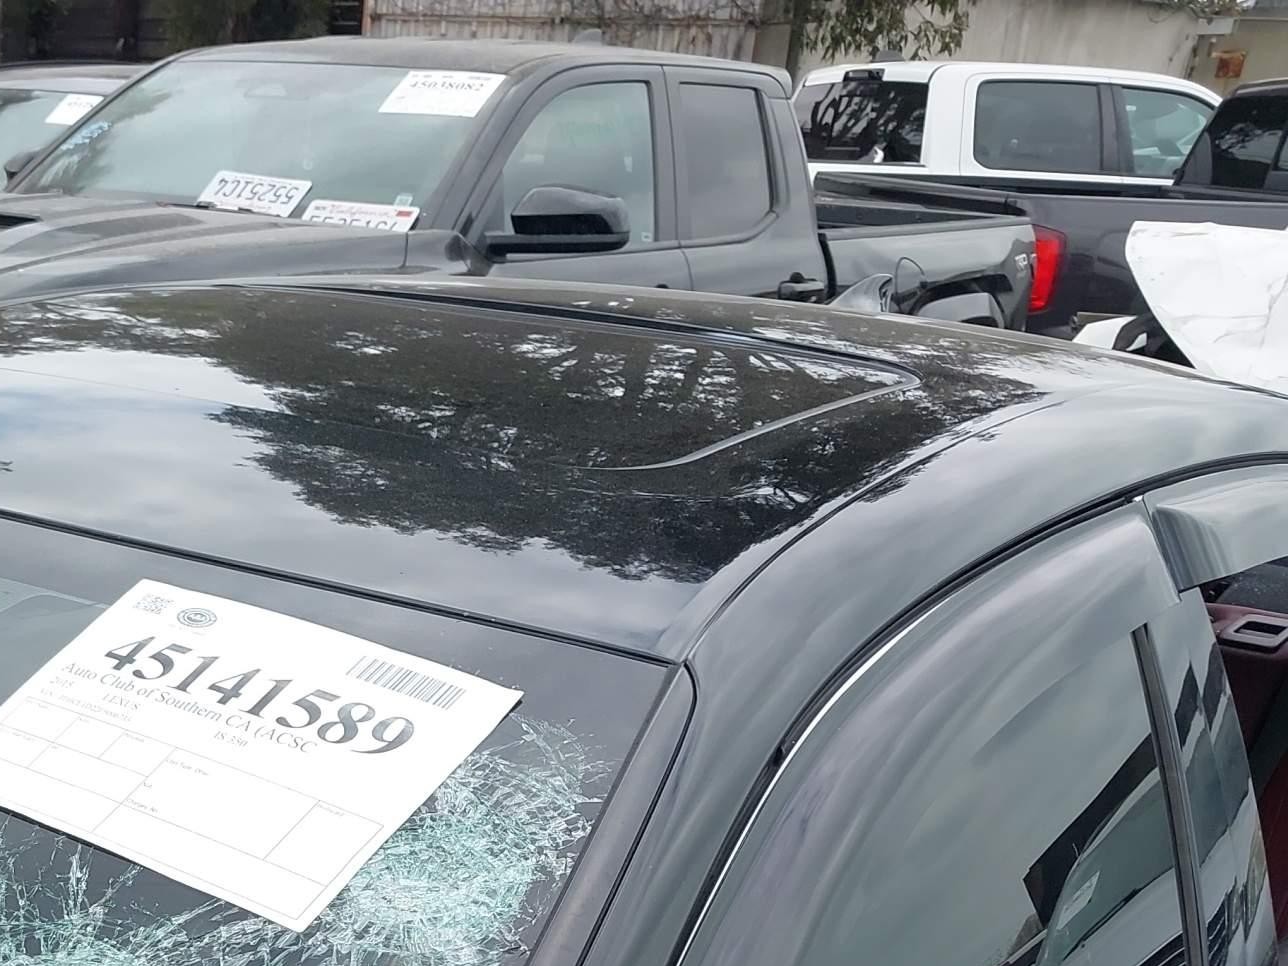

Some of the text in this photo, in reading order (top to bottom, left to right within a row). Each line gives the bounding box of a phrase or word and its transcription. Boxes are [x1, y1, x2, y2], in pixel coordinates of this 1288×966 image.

[216, 178, 300, 205] 55251C4
[62, 662, 98, 680] Auto
[100, 673, 137, 693] Club
[137, 686, 157, 699] of
[154, 689, 222, 723] Southern
[225, 714, 252, 733] CA
[254, 725, 319, 754] (ACSC
[105, 636, 414, 754] 45141589
